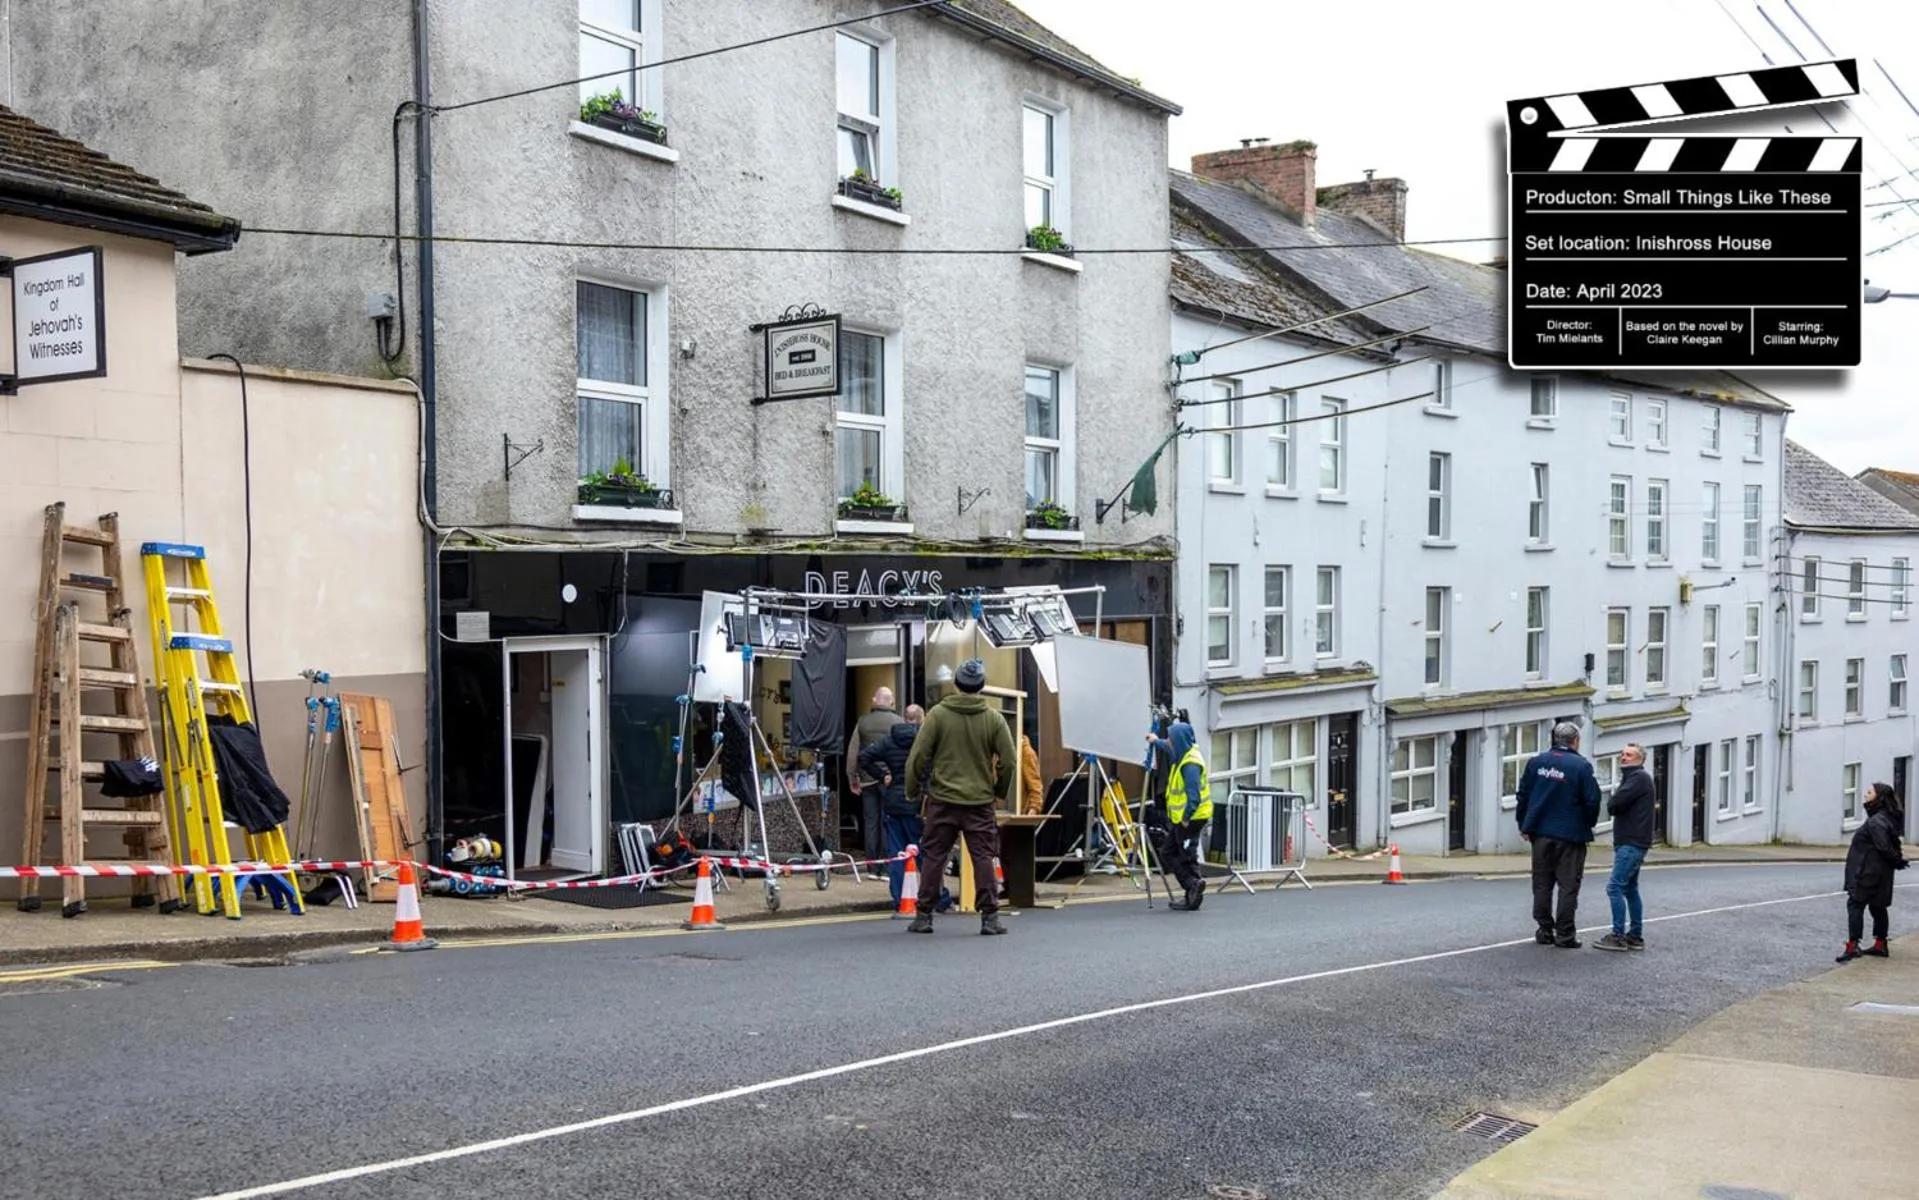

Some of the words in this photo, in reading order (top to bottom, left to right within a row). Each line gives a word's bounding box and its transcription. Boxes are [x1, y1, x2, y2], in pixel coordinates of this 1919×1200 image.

[24, 278, 64, 296] Kingdom
[67, 272, 85, 288] Hall
[49, 297, 59, 311] of
[29, 314, 83, 337] Jehovah's
[29, 340, 83, 359] Witnesses
[805, 568, 943, 609] DEACY'S
